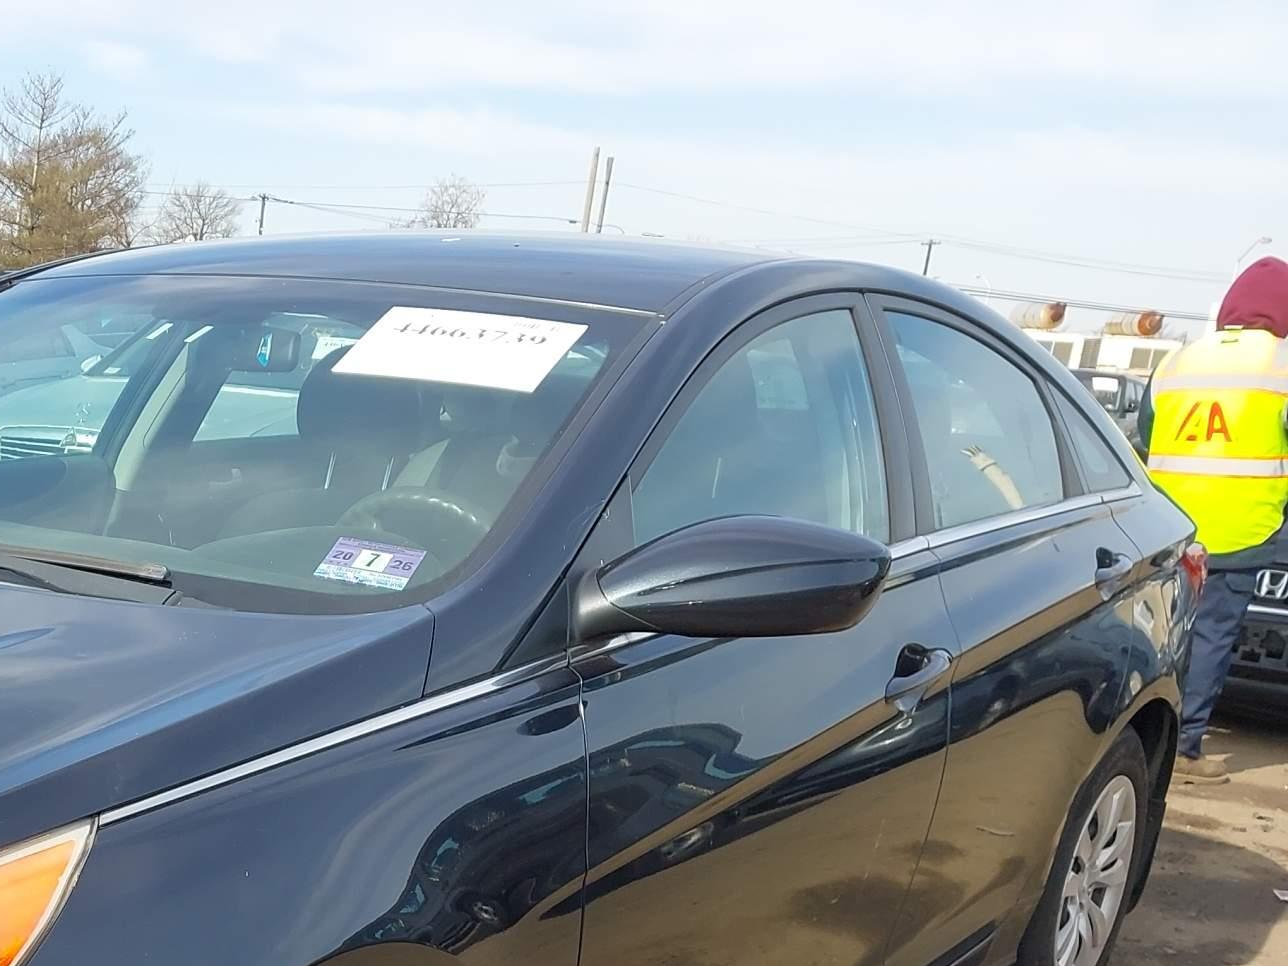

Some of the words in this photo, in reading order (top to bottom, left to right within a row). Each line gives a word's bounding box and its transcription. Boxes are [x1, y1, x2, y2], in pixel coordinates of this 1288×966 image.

[332, 550, 355, 561] 20
[365, 552, 380, 568] 7
[390, 559, 414, 572] 26
